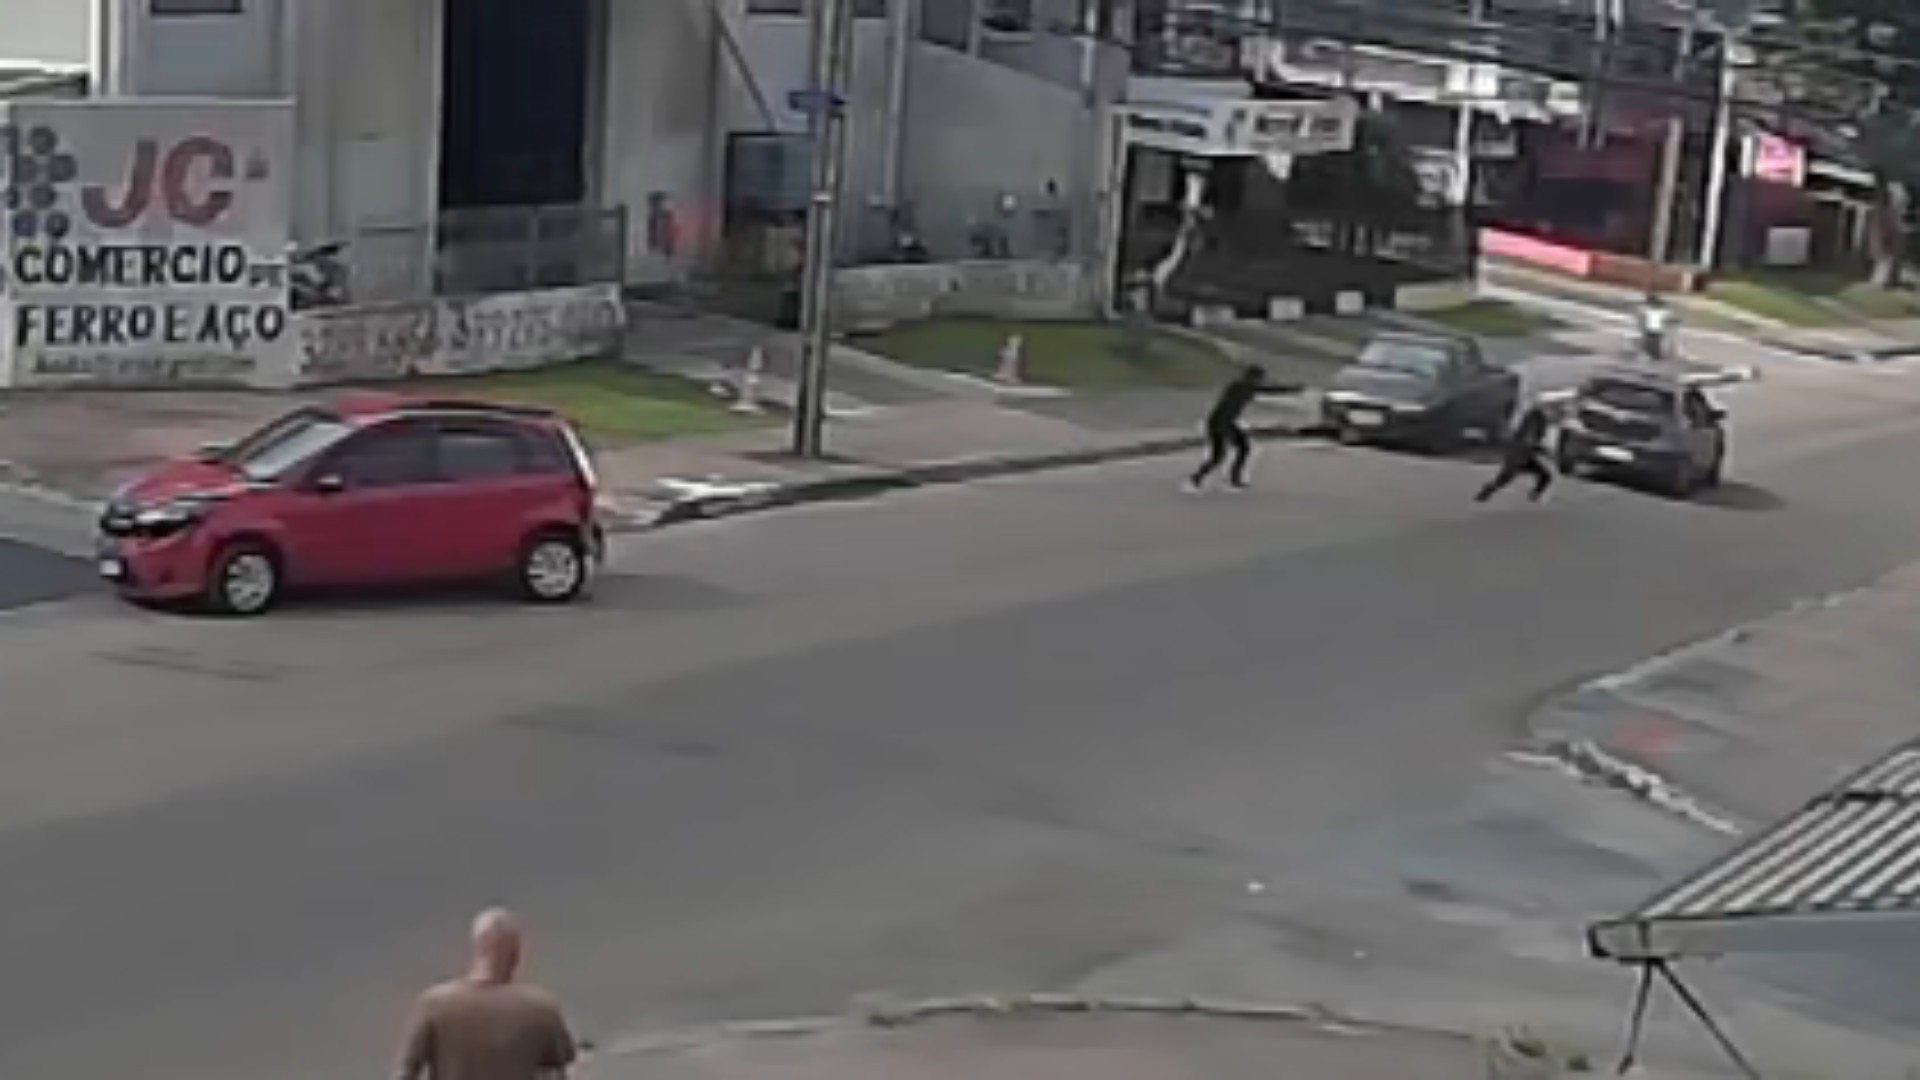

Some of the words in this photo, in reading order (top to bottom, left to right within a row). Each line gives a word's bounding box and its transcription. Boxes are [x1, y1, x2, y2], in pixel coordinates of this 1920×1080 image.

[82, 136, 235, 229] JC
[15, 245, 246, 285] COMERCIO
[17, 304, 155, 347] FERRO
[163, 304, 190, 343] E
[197, 304, 285, 351] AÇO
